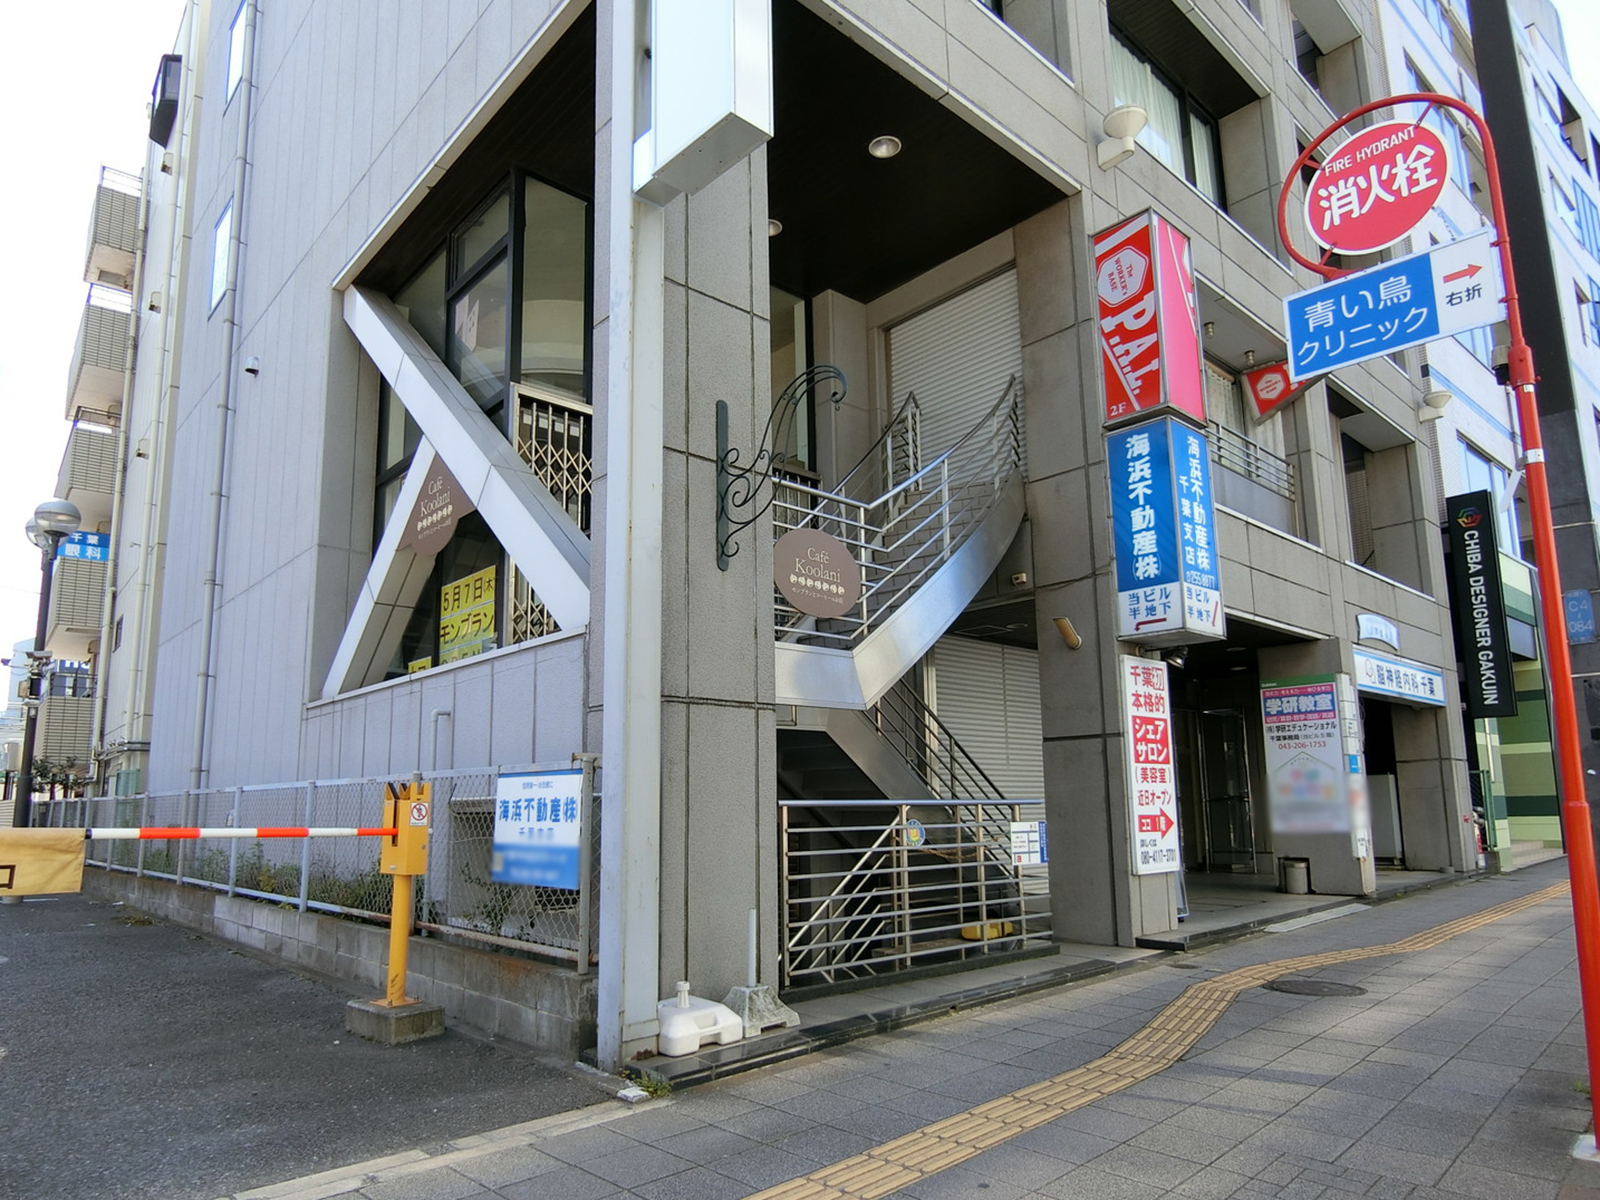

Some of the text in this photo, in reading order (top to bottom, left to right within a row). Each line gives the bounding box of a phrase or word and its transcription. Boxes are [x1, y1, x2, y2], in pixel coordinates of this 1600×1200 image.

[1324, 126, 1416, 177] FIRE HYDRANT
[1316, 144, 1438, 231] 消火栓
[1107, 271, 1118, 293] BASE
[1303, 275, 1412, 333] 青い鳥
[1446, 283, 1483, 307] 右折
[1297, 307, 1428, 366] クリニック
[1109, 402, 1127, 417] 2F
[420, 486, 451, 517] Koolani
[1179, 475, 1196, 565] 千葉支店
[71, 532, 99, 545] 千葉
[65, 545, 101, 560] 眼科
[807, 547, 829, 564] Café
[794, 557, 841, 582] Koolani
[1128, 587, 1171, 606] 当ビル
[1186, 586, 1210, 604] 当ビル
[1128, 602, 1171, 620] 半地下
[1463, 530, 1499, 706] CHIBA DESIGNER GAKUIN
[440, 612, 494, 645] モンブラン
[1131, 690, 1165, 714] 本格的
[1265, 693, 1333, 715] 学研教室
[1135, 718, 1165, 741] シェア
[1135, 741, 1168, 762] サロン
[1278, 740, 1327, 750] 043-206-1753
[1138, 789, 1172, 806] 近日オープン
